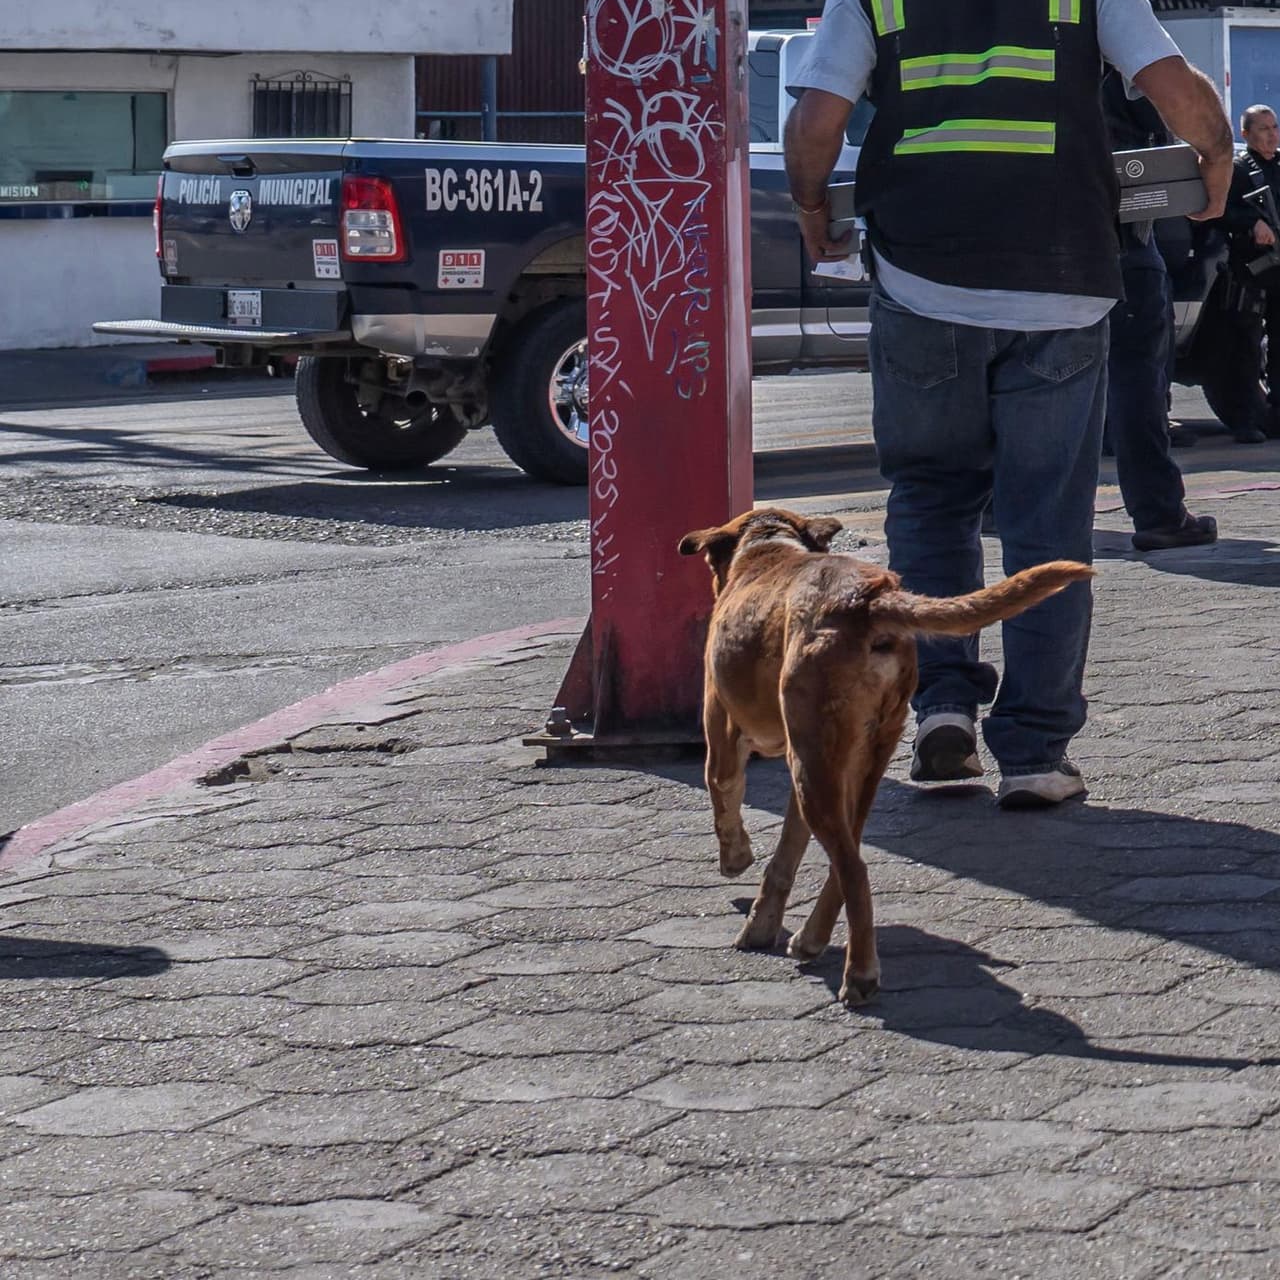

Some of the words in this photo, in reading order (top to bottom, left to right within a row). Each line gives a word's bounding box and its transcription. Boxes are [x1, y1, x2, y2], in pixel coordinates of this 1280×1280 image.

[179, 175, 220, 204] POLICÍA
[258, 179, 333, 205] MUNICIPAL
[426, 168, 544, 212] BC-361A-2
[316, 243, 336, 256] 911
[444, 253, 481, 266] 911
